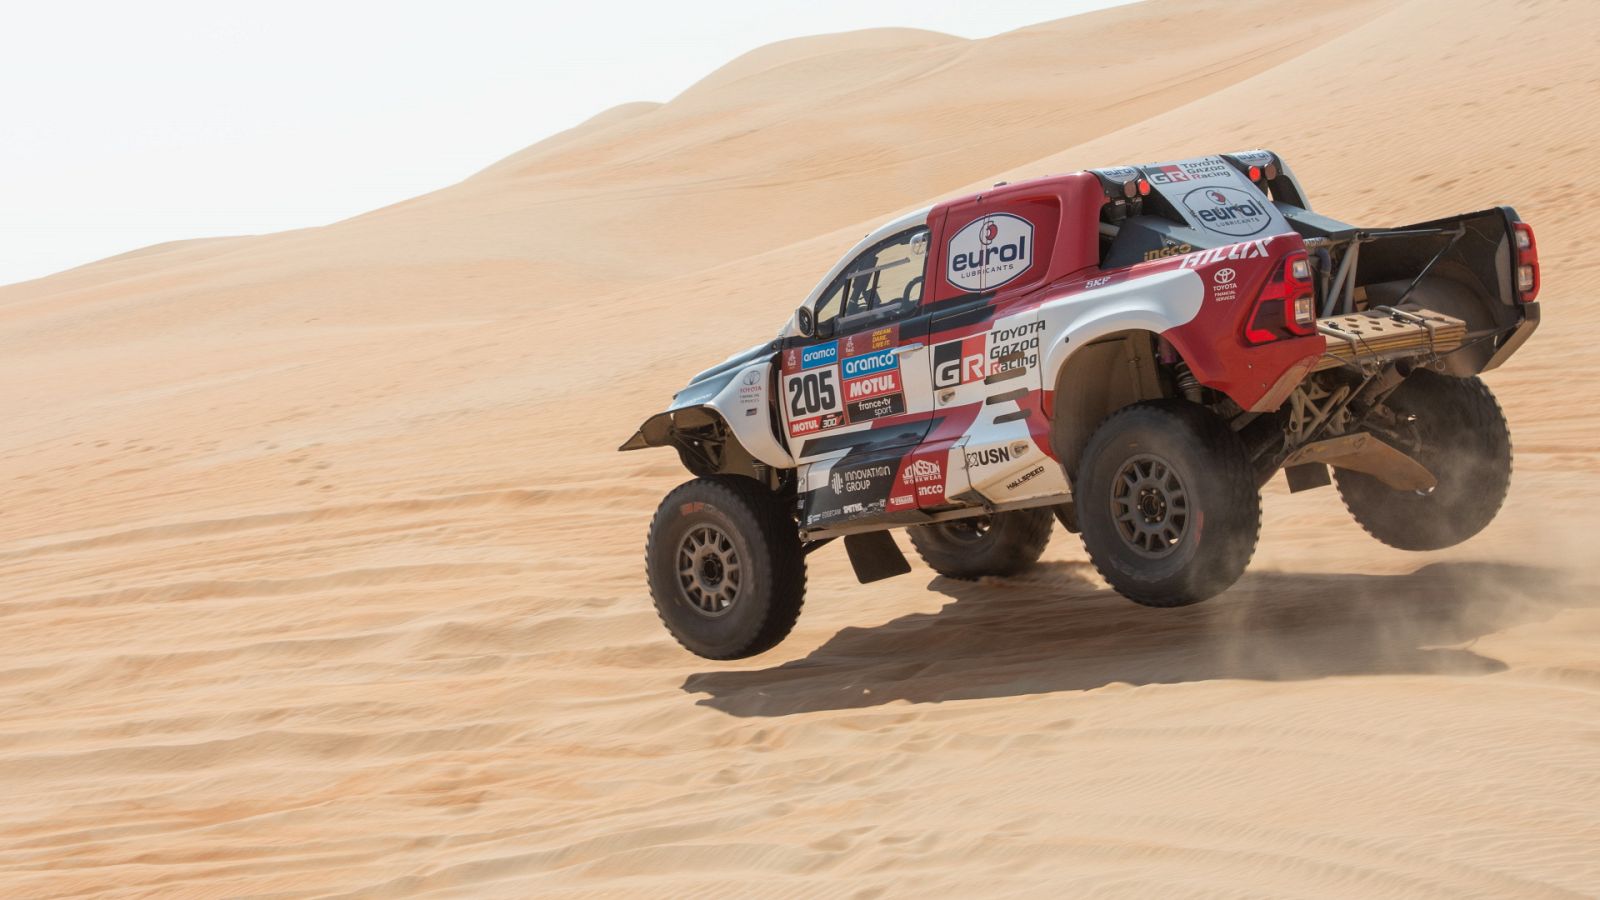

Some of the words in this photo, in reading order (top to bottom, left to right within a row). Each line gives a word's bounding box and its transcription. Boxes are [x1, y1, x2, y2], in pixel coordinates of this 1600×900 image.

[1183, 159, 1224, 168] TOYOTA
[1187, 165, 1226, 174] GAZOO
[1151, 171, 1190, 184] GR
[1191, 171, 1231, 179] Racing
[1199, 199, 1263, 221] eurol
[953, 236, 1025, 272] eurol
[961, 263, 1014, 279] LUBRICANTS
[1213, 283, 1237, 291] TOYOTA
[990, 320, 1046, 344] TOYOTA
[803, 347, 836, 362] aramco
[990, 337, 1039, 360] GAZOO
[845, 353, 894, 374] aramco
[935, 353, 985, 388] GR
[990, 354, 1037, 376] Racing
[788, 369, 837, 418] 205
[850, 374, 896, 399] MOTUL
[874, 405, 893, 417] sport
[792, 420, 819, 433] MOTUL
[978, 446, 1010, 466] USN
[903, 460, 941, 479] JONSSON
[1007, 465, 1045, 490] HALLSPEED
[846, 479, 871, 492] GROUP
